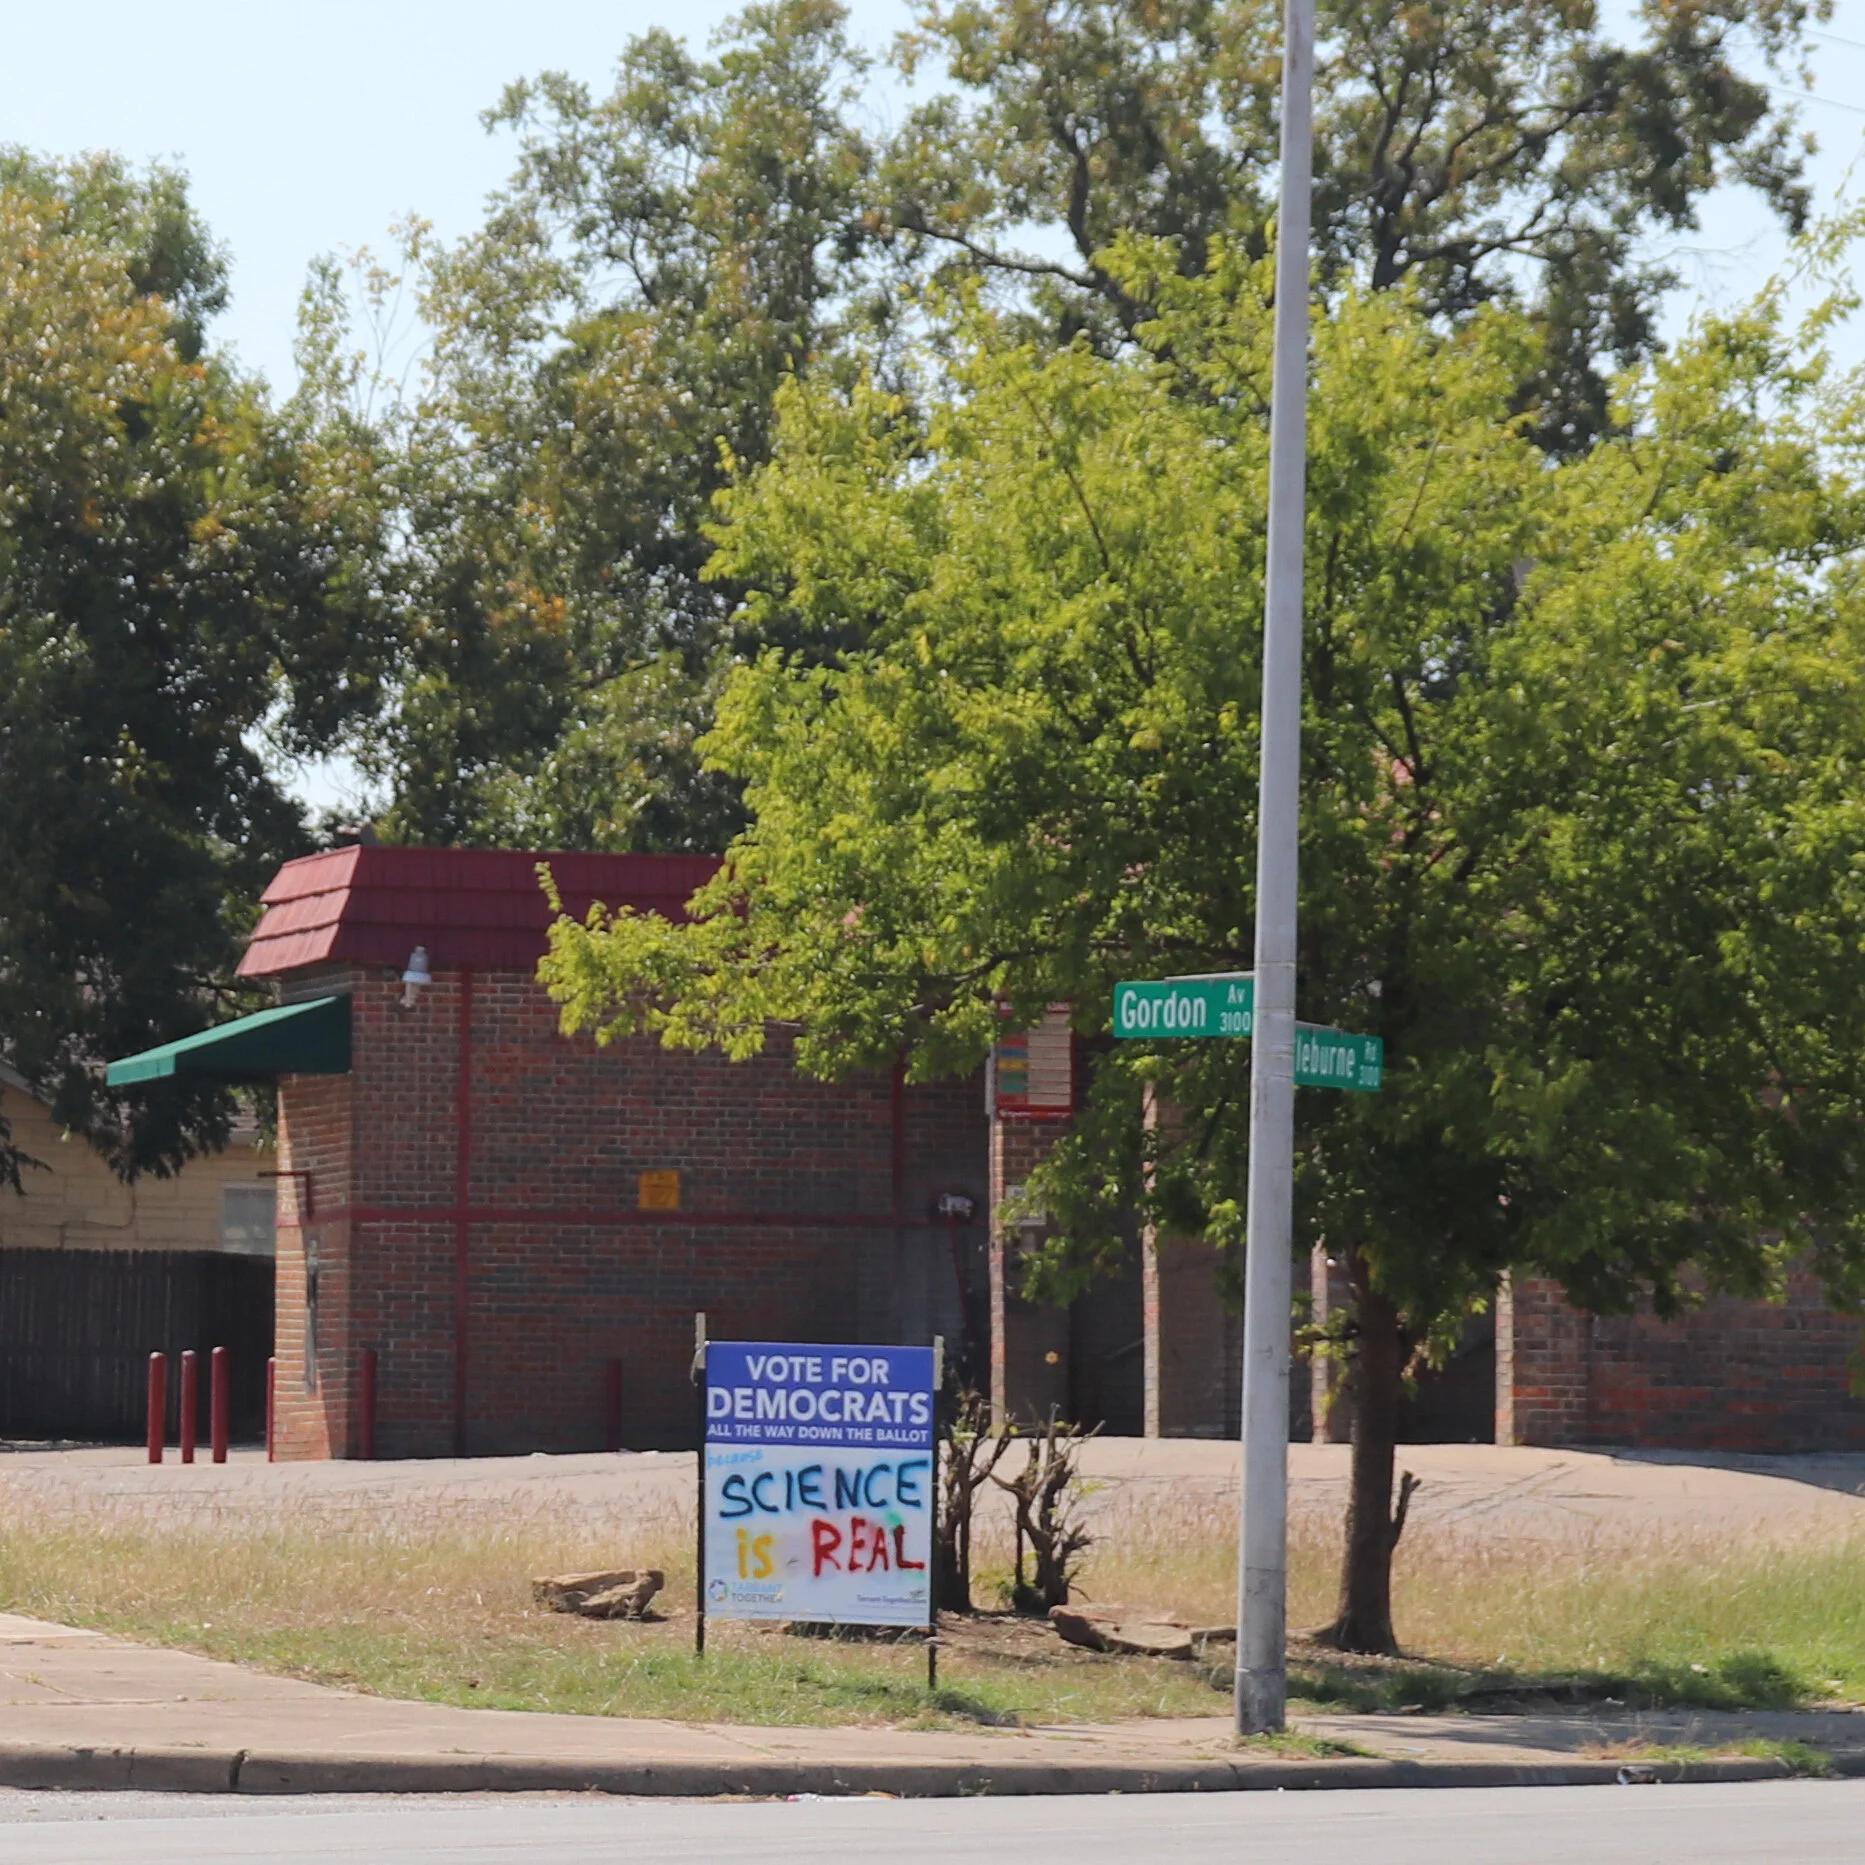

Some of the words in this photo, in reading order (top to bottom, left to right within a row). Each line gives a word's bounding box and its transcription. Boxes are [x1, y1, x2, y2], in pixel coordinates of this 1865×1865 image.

[1121, 990, 1207, 1030] Gordon
[1227, 983, 1246, 1004] Av
[1219, 1011, 1252, 1033] 3100
[1295, 1034, 1355, 1079] leburne
[745, 1355, 823, 1384] VOTE
[831, 1357, 890, 1385] FOR
[707, 1386, 930, 1424] DEMOCRATS
[706, 1424, 732, 1437] ALL
[735, 1424, 761, 1438] THE
[764, 1425, 796, 1439] WAY
[798, 1426, 843, 1440] DOWN
[845, 1427, 873, 1441] THE
[876, 1428, 929, 1443] BALLOT
[719, 1460, 930, 1518] SCIENCE
[812, 1516, 925, 1578] REAL
